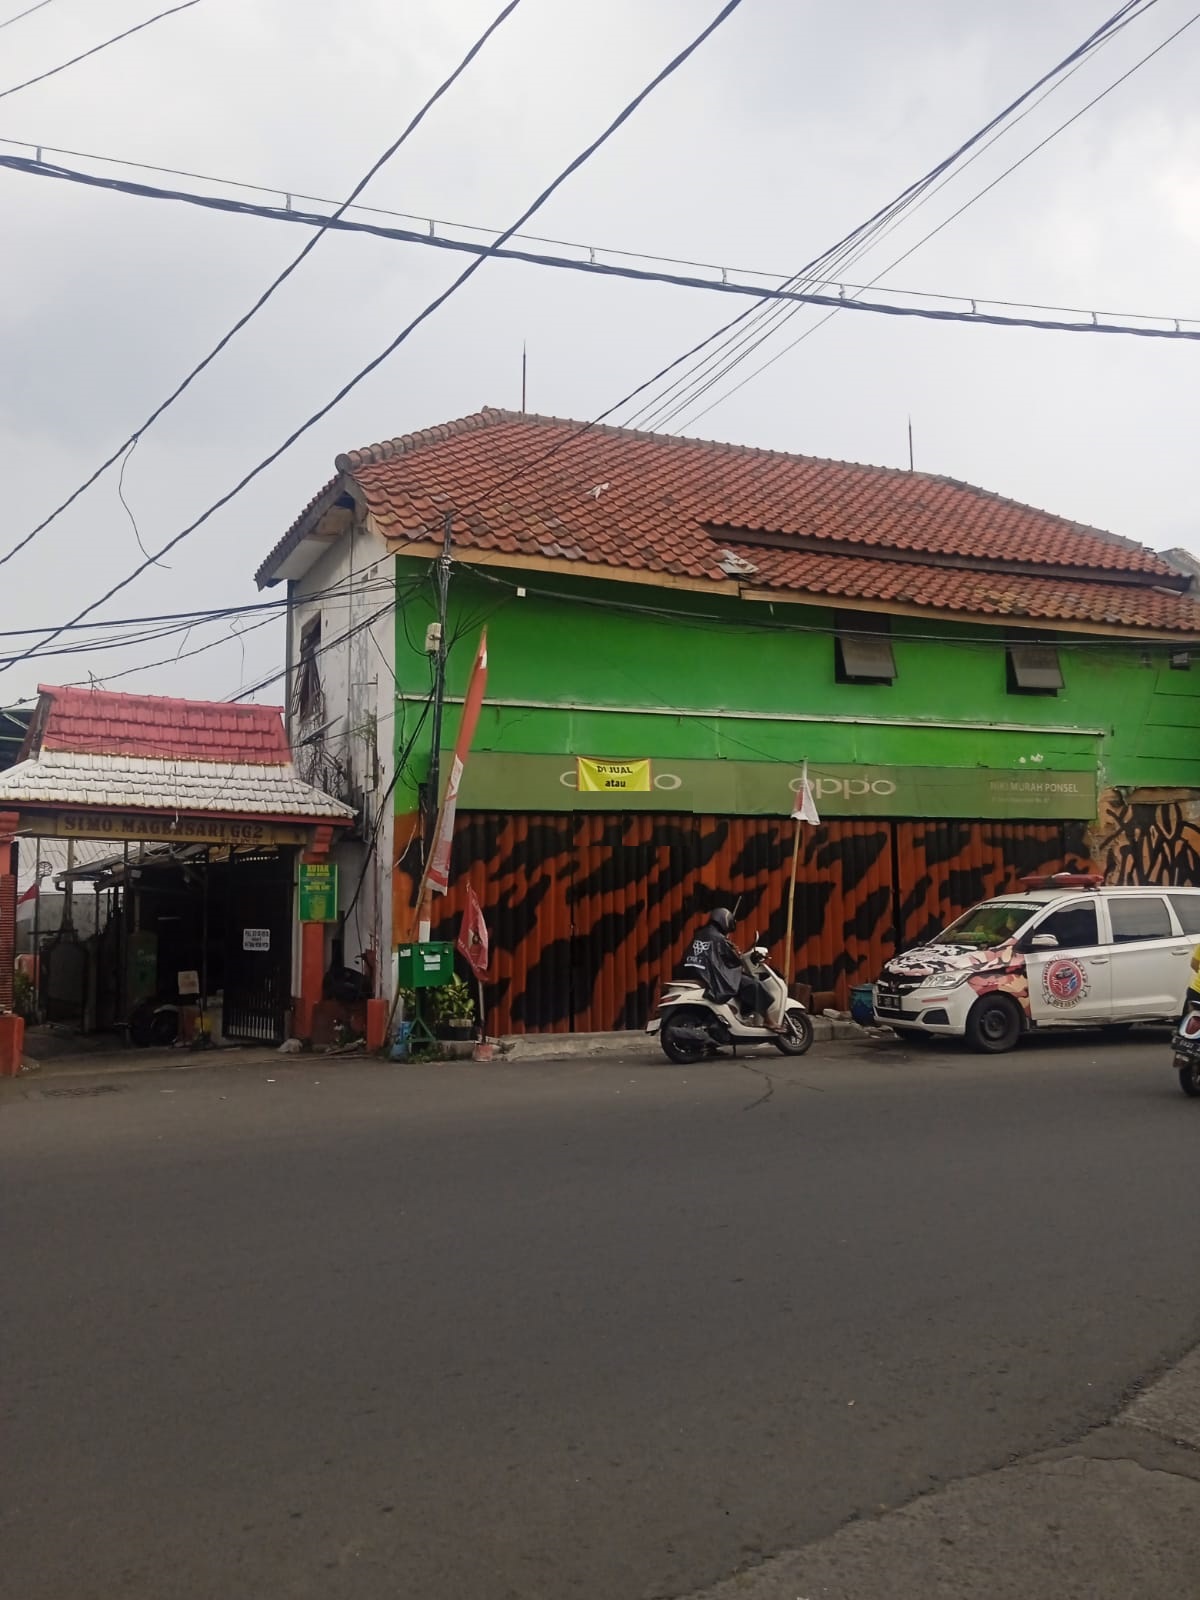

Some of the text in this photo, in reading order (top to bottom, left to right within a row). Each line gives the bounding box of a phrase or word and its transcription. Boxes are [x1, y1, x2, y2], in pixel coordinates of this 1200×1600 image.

[597, 765, 633, 774] DI JUAL
[605, 779, 626, 788] atau
[1045, 783, 1079, 793] PONSEL
